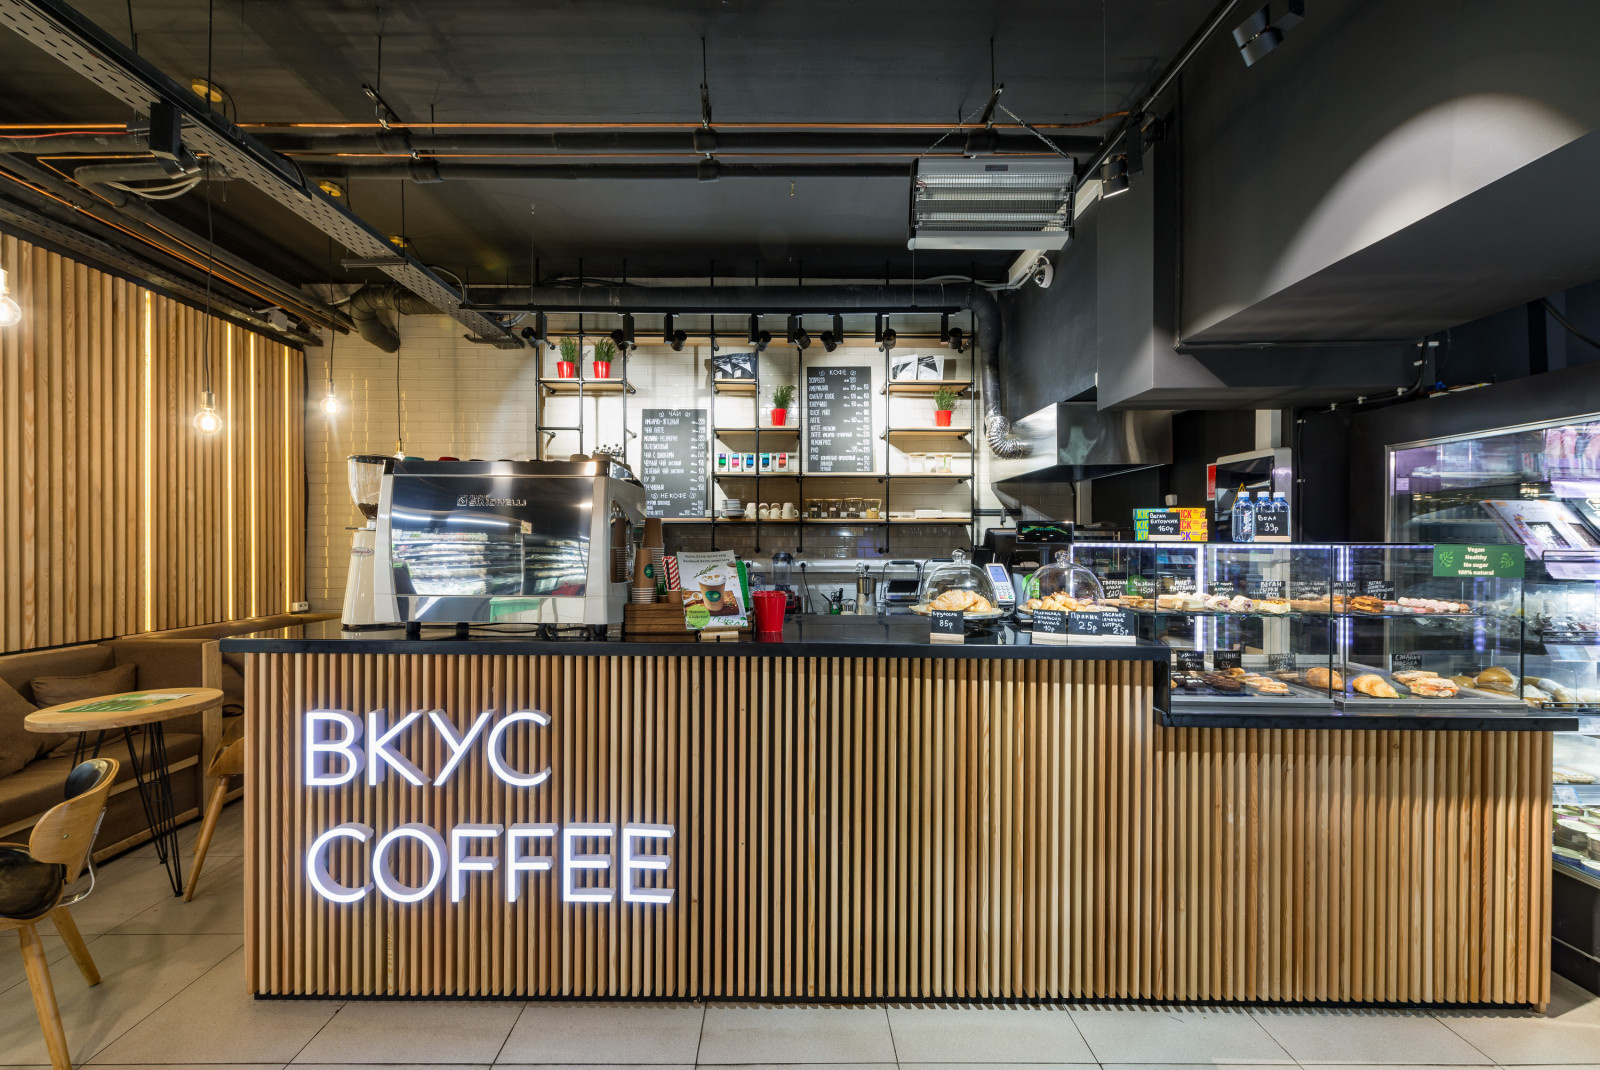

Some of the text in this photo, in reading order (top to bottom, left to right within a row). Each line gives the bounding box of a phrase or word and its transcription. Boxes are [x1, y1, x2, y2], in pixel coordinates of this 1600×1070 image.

[1464, 554, 1488, 562] Healthy
[1078, 621, 1098, 633] 25р
[307, 822, 675, 904] COFFEE
